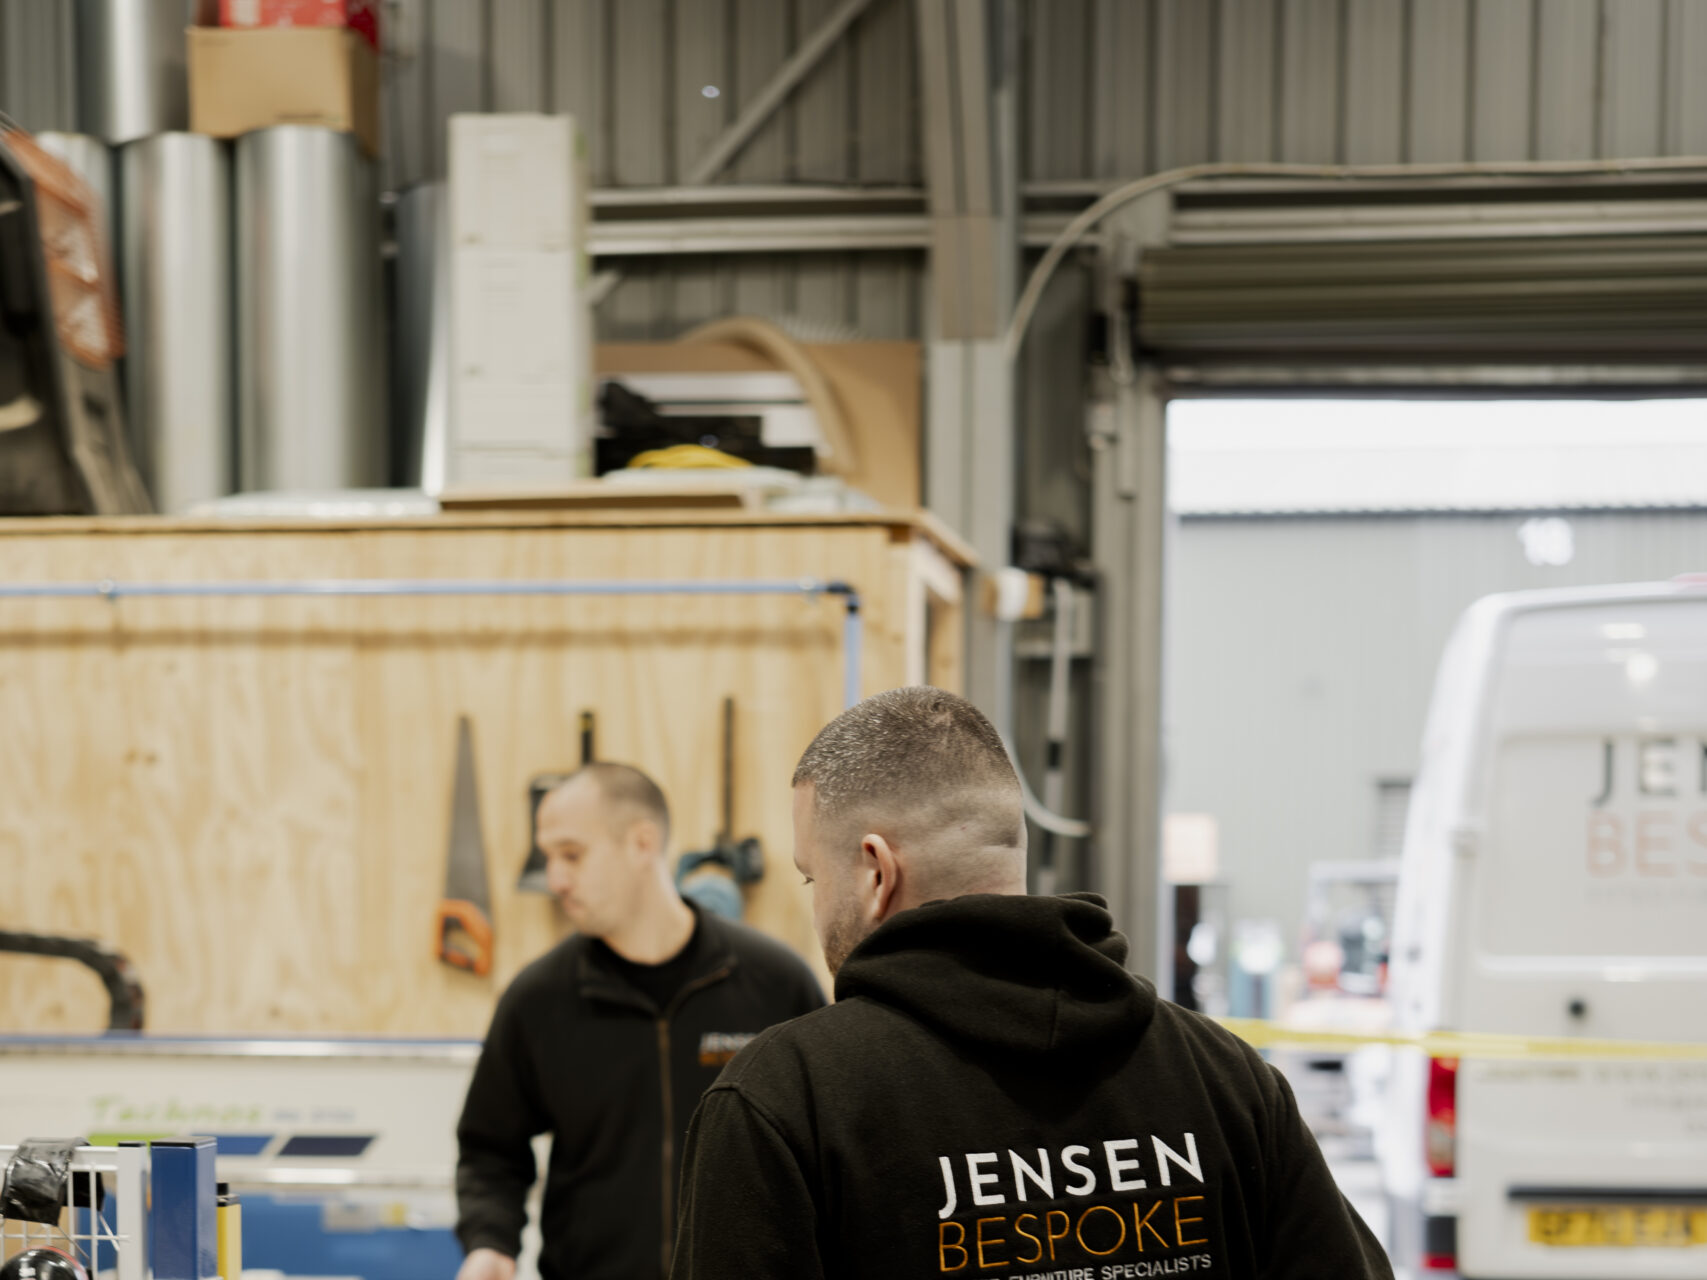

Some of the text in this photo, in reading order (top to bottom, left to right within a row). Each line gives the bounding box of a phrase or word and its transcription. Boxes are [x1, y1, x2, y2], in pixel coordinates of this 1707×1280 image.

[1590, 736, 1707, 809] JE
[938, 1132, 1204, 1219] JENSEN
[939, 1195, 1208, 1271] BESPOKE
[1100, 1254, 1212, 1280] SPECIALISTS
